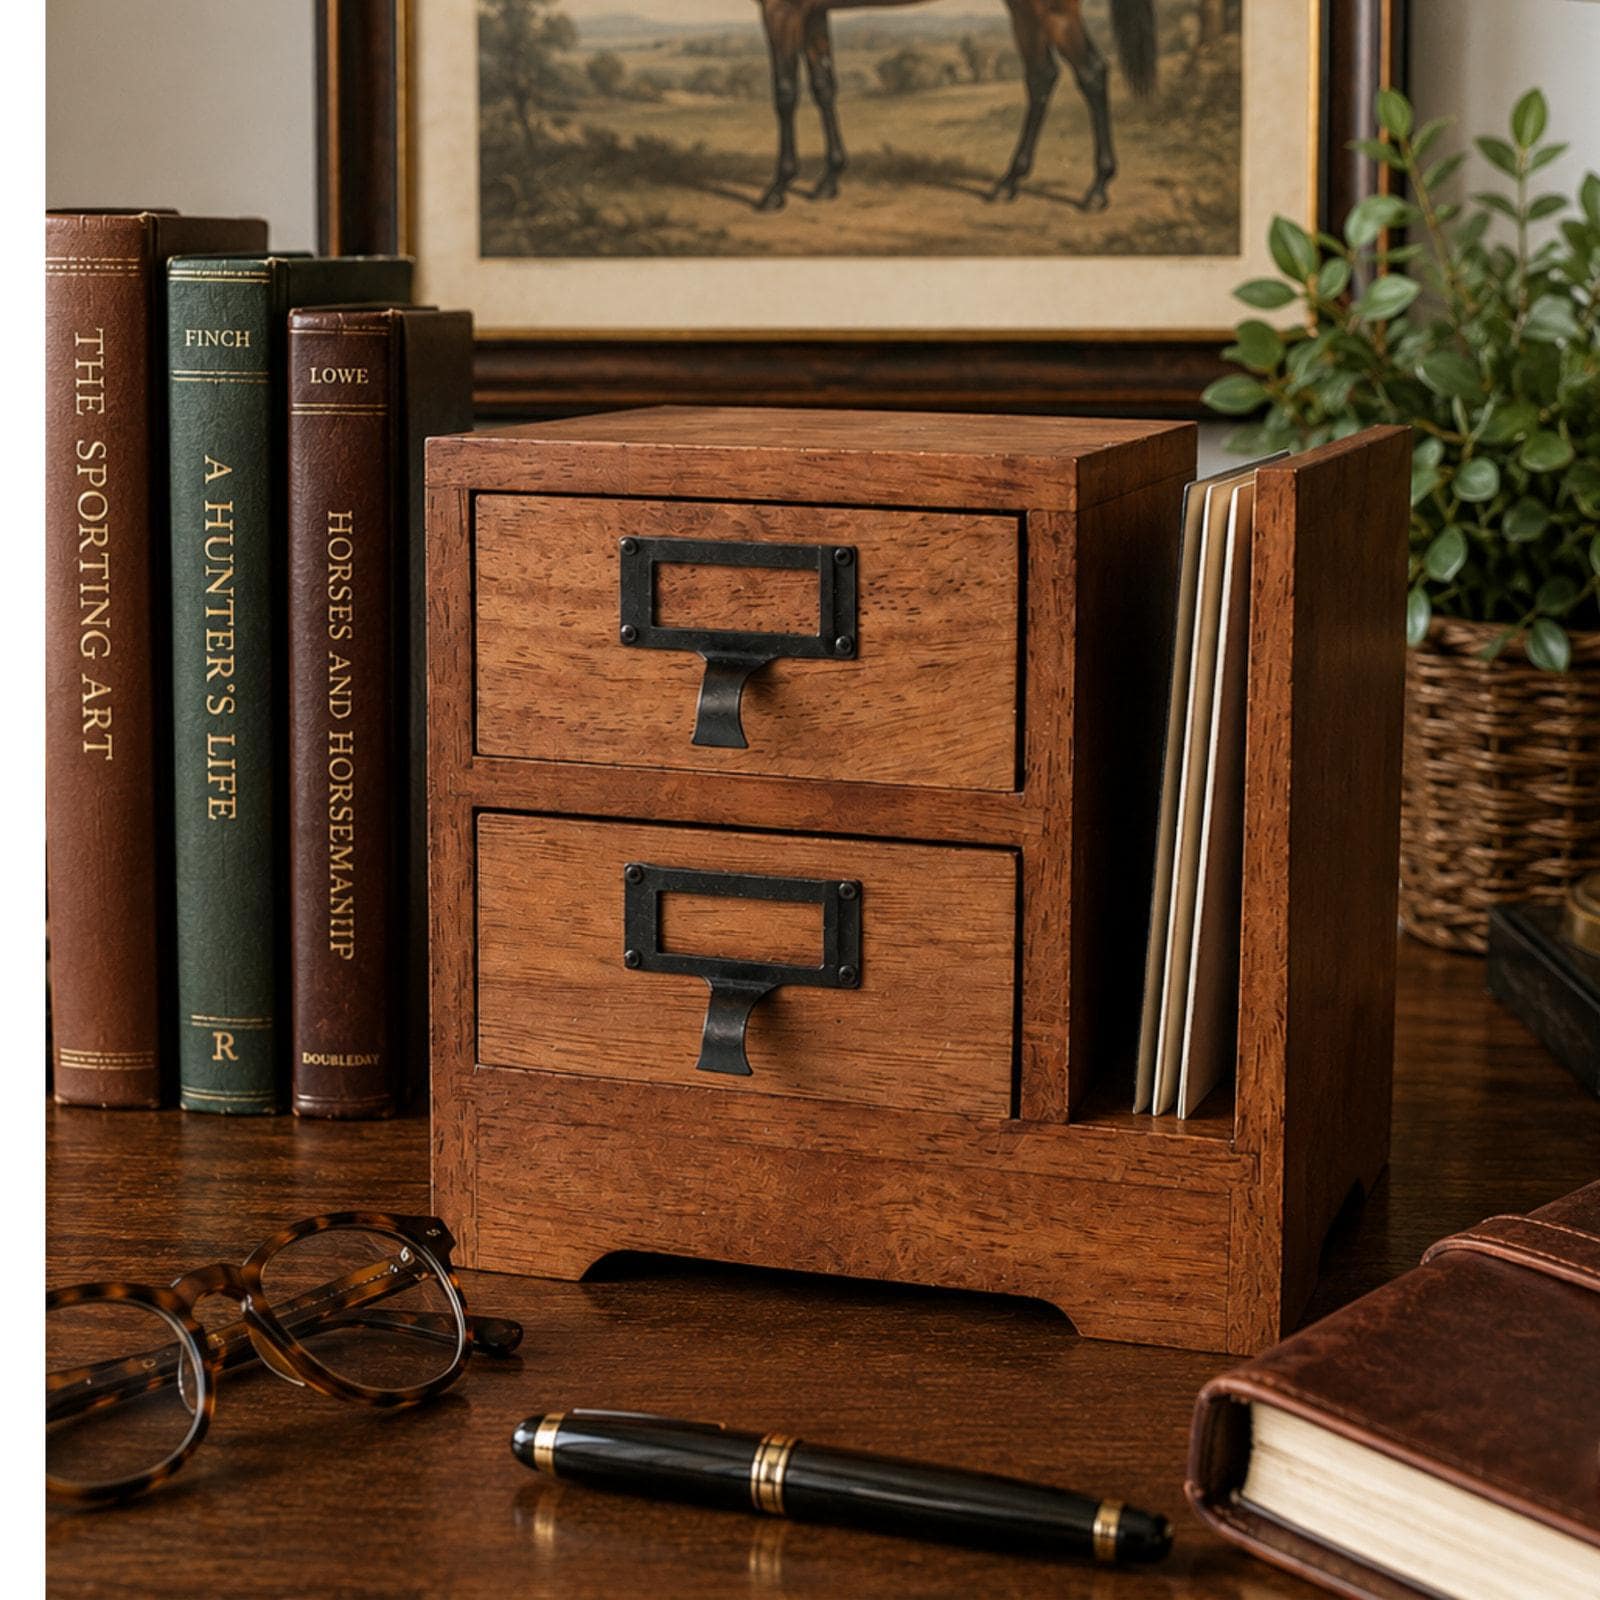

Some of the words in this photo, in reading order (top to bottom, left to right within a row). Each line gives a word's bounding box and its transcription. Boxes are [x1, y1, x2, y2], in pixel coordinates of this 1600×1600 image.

[74, 328, 105, 415] THE
[185, 329, 251, 348] FINCH
[310, 367, 369, 385] LOWE
[204, 455, 232, 484] A
[76, 440, 111, 660] SPORTING
[327, 511, 353, 640] HORSES
[204, 500, 236, 716] HUNTER'S
[82, 673, 113, 760] ART
[328, 651, 354, 720] AND
[207, 733, 237, 821] LIFE
[211, 1031, 239, 1061] R
[302, 1052, 381, 1067] DOUBLEDAY
